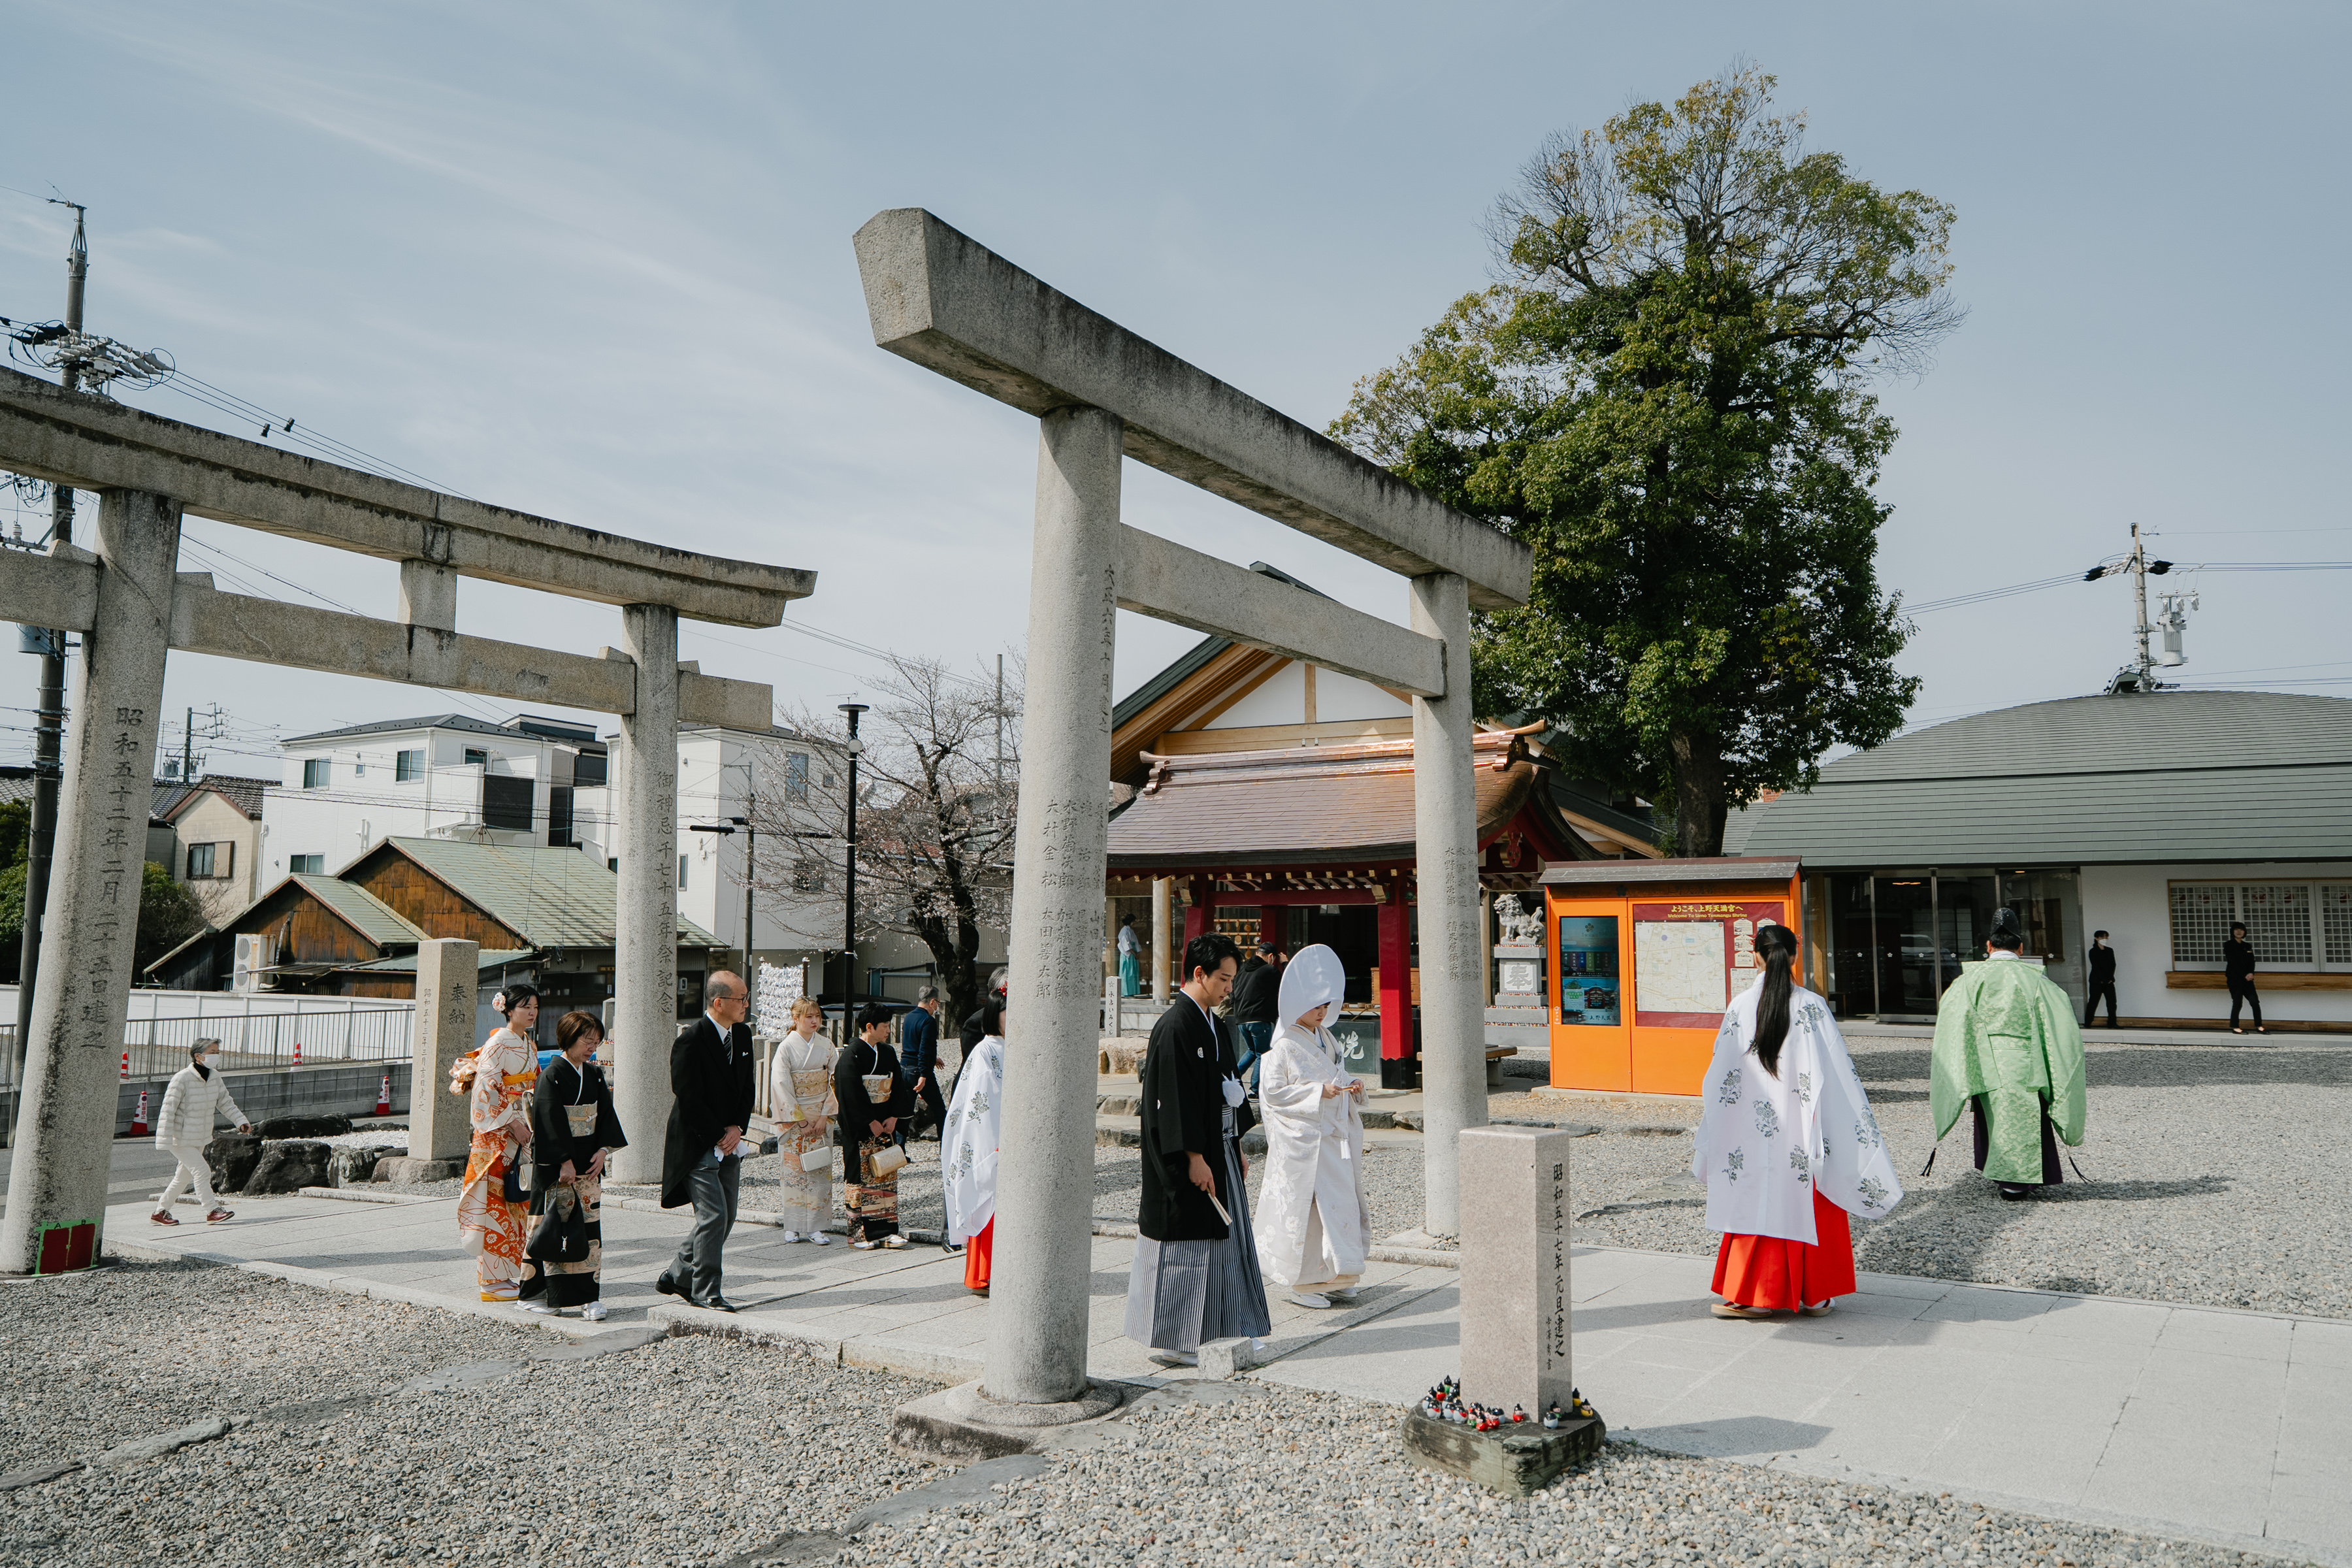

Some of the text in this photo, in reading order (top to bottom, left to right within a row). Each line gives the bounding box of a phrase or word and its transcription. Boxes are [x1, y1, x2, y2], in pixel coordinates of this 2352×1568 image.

[80, 707, 144, 1050] 昭和五十二年二月二十五日建之
[655, 771, 674, 1014] 御神忌千七十五年祭記念
[1671, 904, 1744, 913] ようこそ、上野天満宮へ
[449, 983, 467, 1024] 奉納
[1507, 964, 1532, 990] 奉
[1553, 1163, 1565, 1357] 昭和五十七年元旦建之
